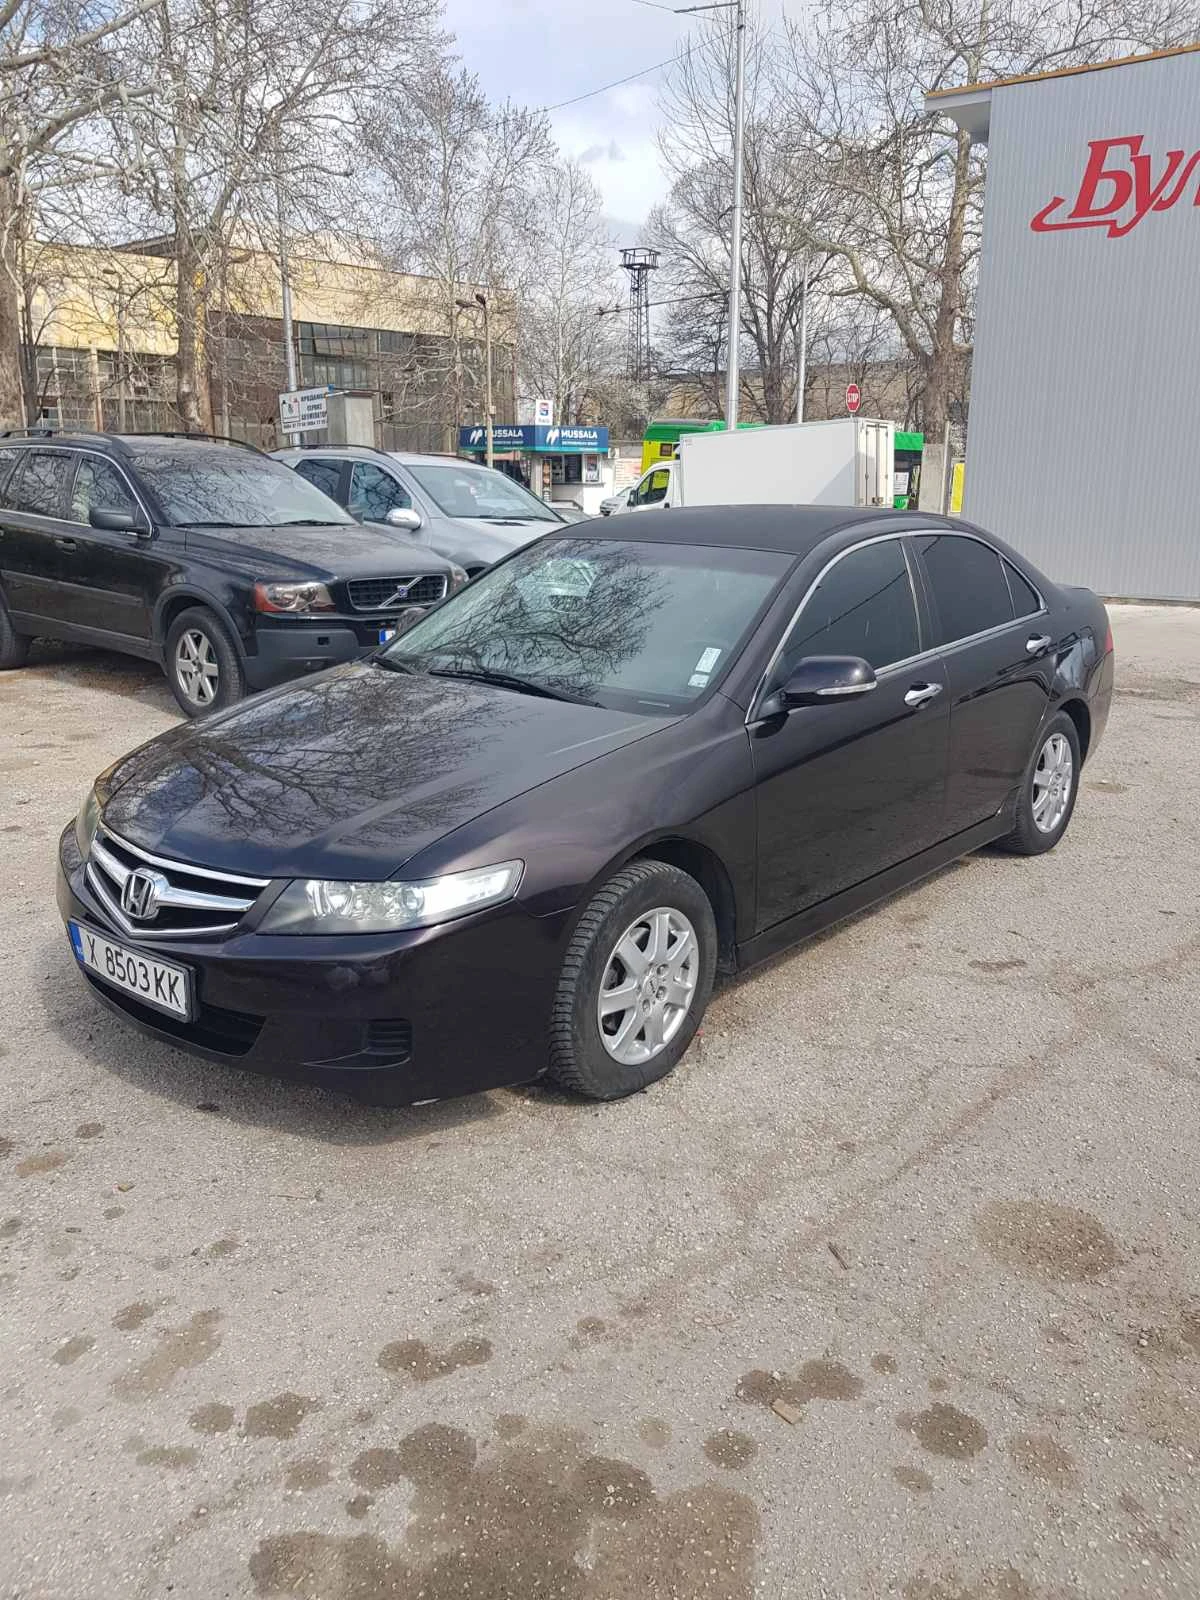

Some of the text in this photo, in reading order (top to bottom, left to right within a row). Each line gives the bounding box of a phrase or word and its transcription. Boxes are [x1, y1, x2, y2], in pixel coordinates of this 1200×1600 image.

[847, 392, 859, 403] STOP
[561, 430, 598, 439] MUSSALA
[87, 935, 99, 967] X
